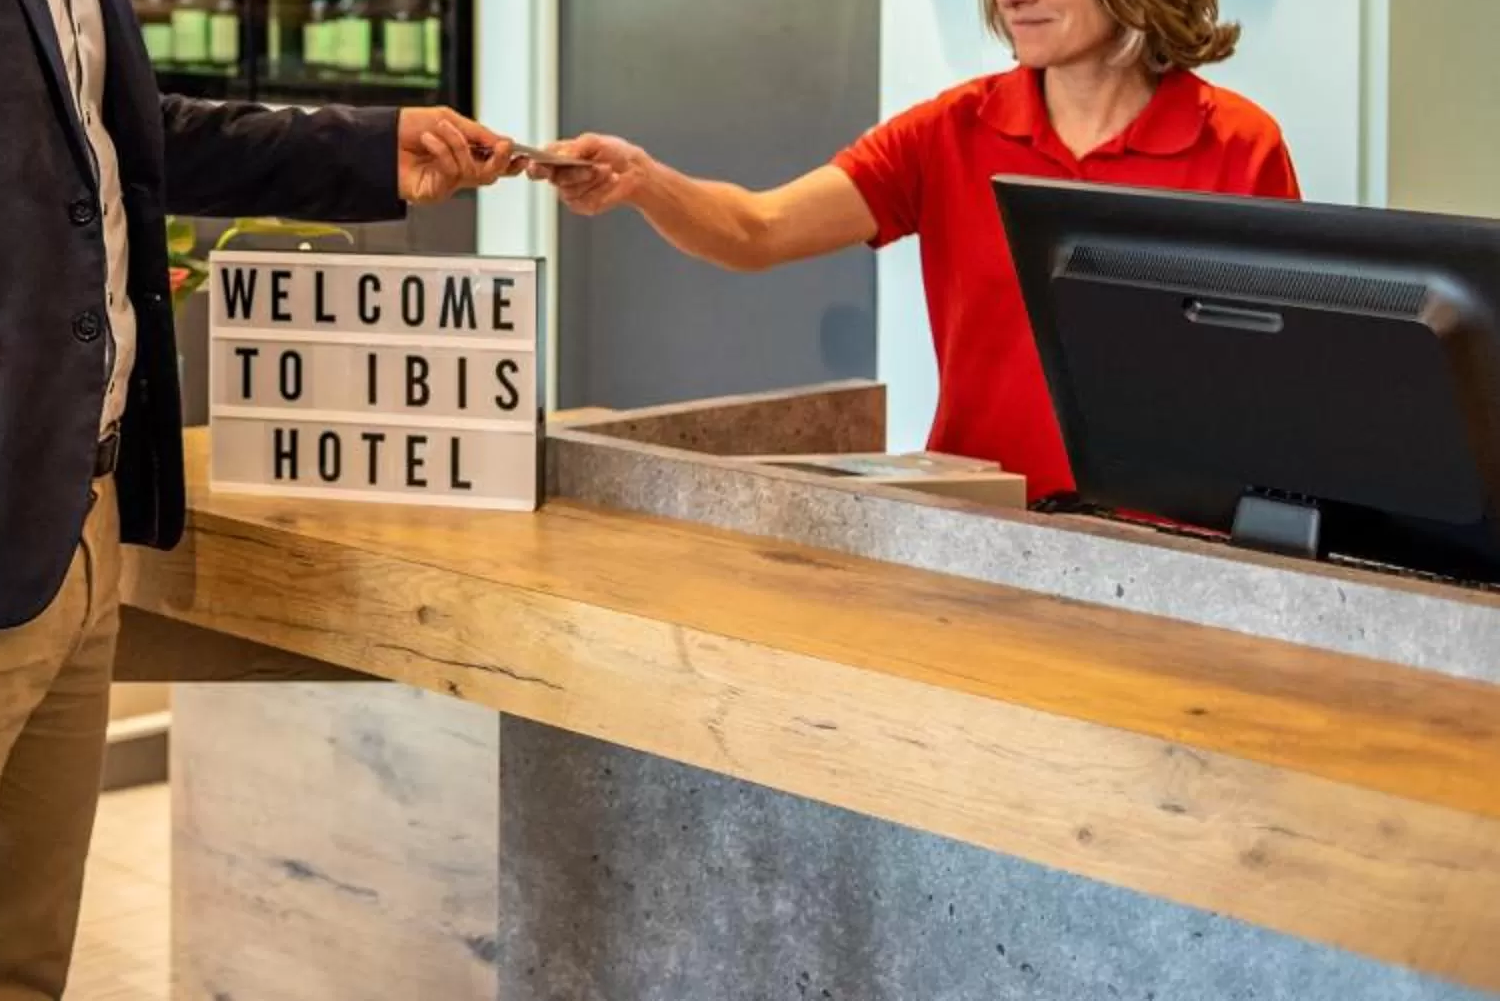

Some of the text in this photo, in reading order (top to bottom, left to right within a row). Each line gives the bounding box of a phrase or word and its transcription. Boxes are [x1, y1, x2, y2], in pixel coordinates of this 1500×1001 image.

[221, 268, 515, 331] WELCOME
[235, 347, 520, 411] TO IBIS
[274, 427, 472, 490] HOTEL
